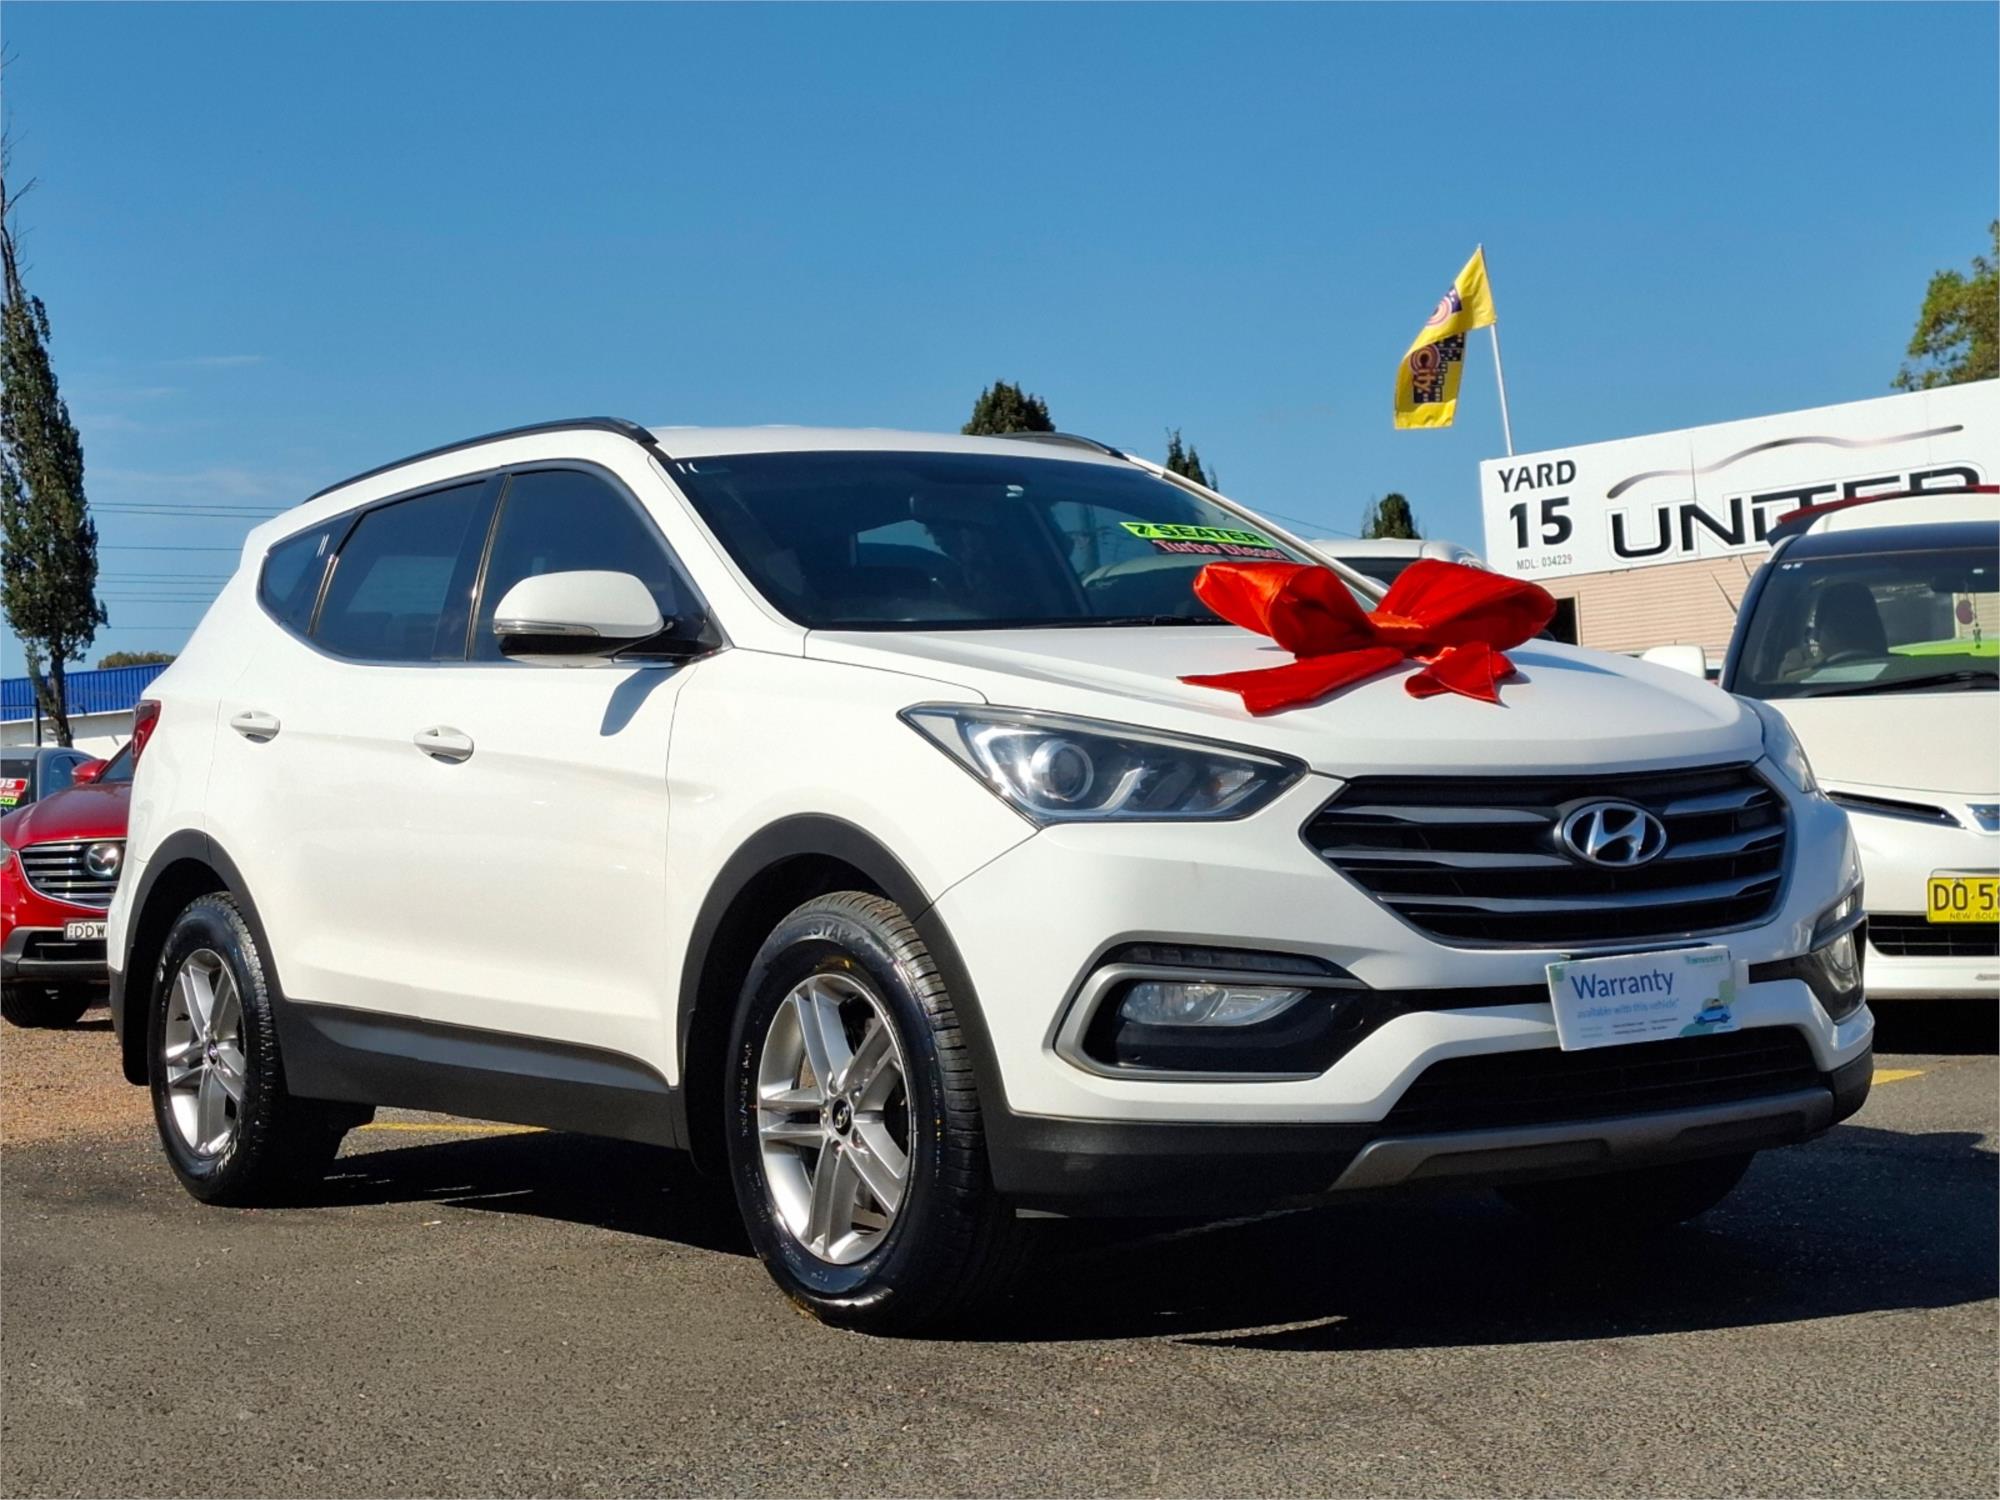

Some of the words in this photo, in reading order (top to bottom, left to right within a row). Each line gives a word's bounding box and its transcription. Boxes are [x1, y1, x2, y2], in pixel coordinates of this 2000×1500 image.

[1498, 460, 1577, 493] YARD
[1153, 524, 1272, 546] SEATER
[1510, 496, 1573, 549] 15
[1152, 539, 1221, 554] Turbo
[1517, 559, 1539, 570] MDL:
[1541, 553, 1573, 568] 034229
[1934, 884, 1968, 911] DO
[1571, 968, 1673, 999] Warranty
